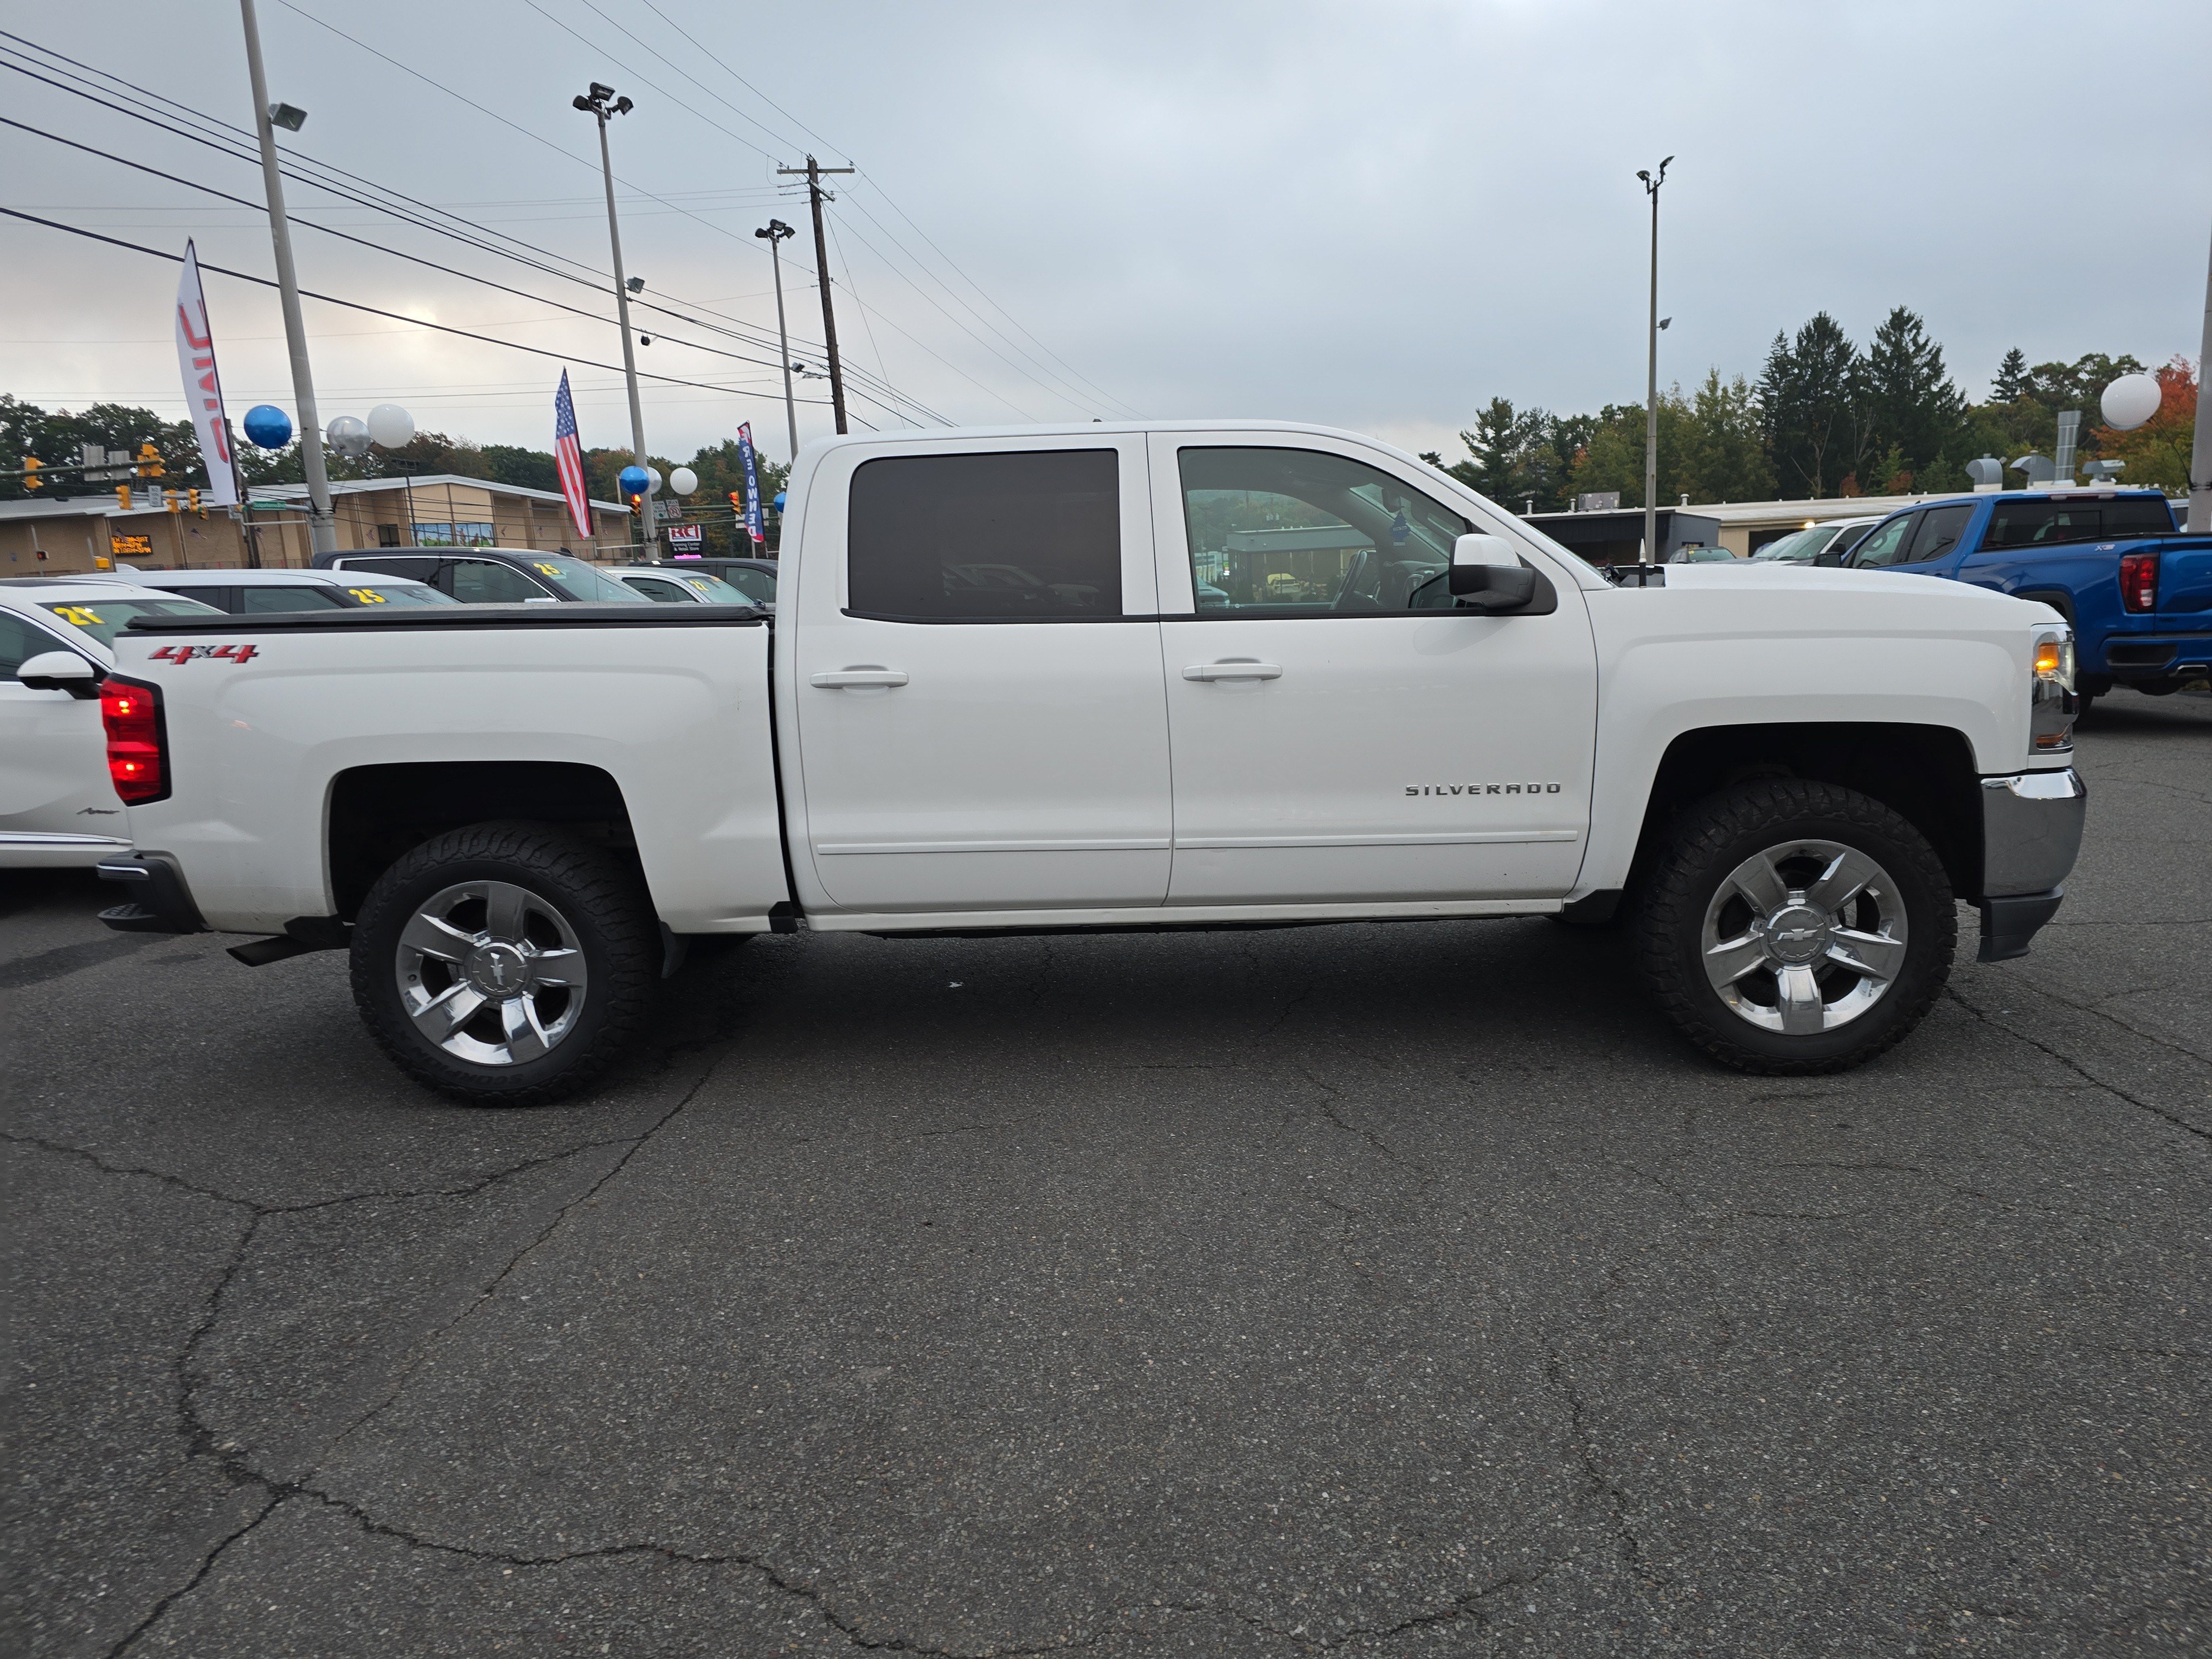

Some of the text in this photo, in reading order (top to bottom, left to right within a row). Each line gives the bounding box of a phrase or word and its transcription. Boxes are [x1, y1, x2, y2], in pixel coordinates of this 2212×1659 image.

[533, 562, 561, 575] 25
[348, 588, 387, 604] 25
[1405, 781, 1561, 796] SILVERADO
